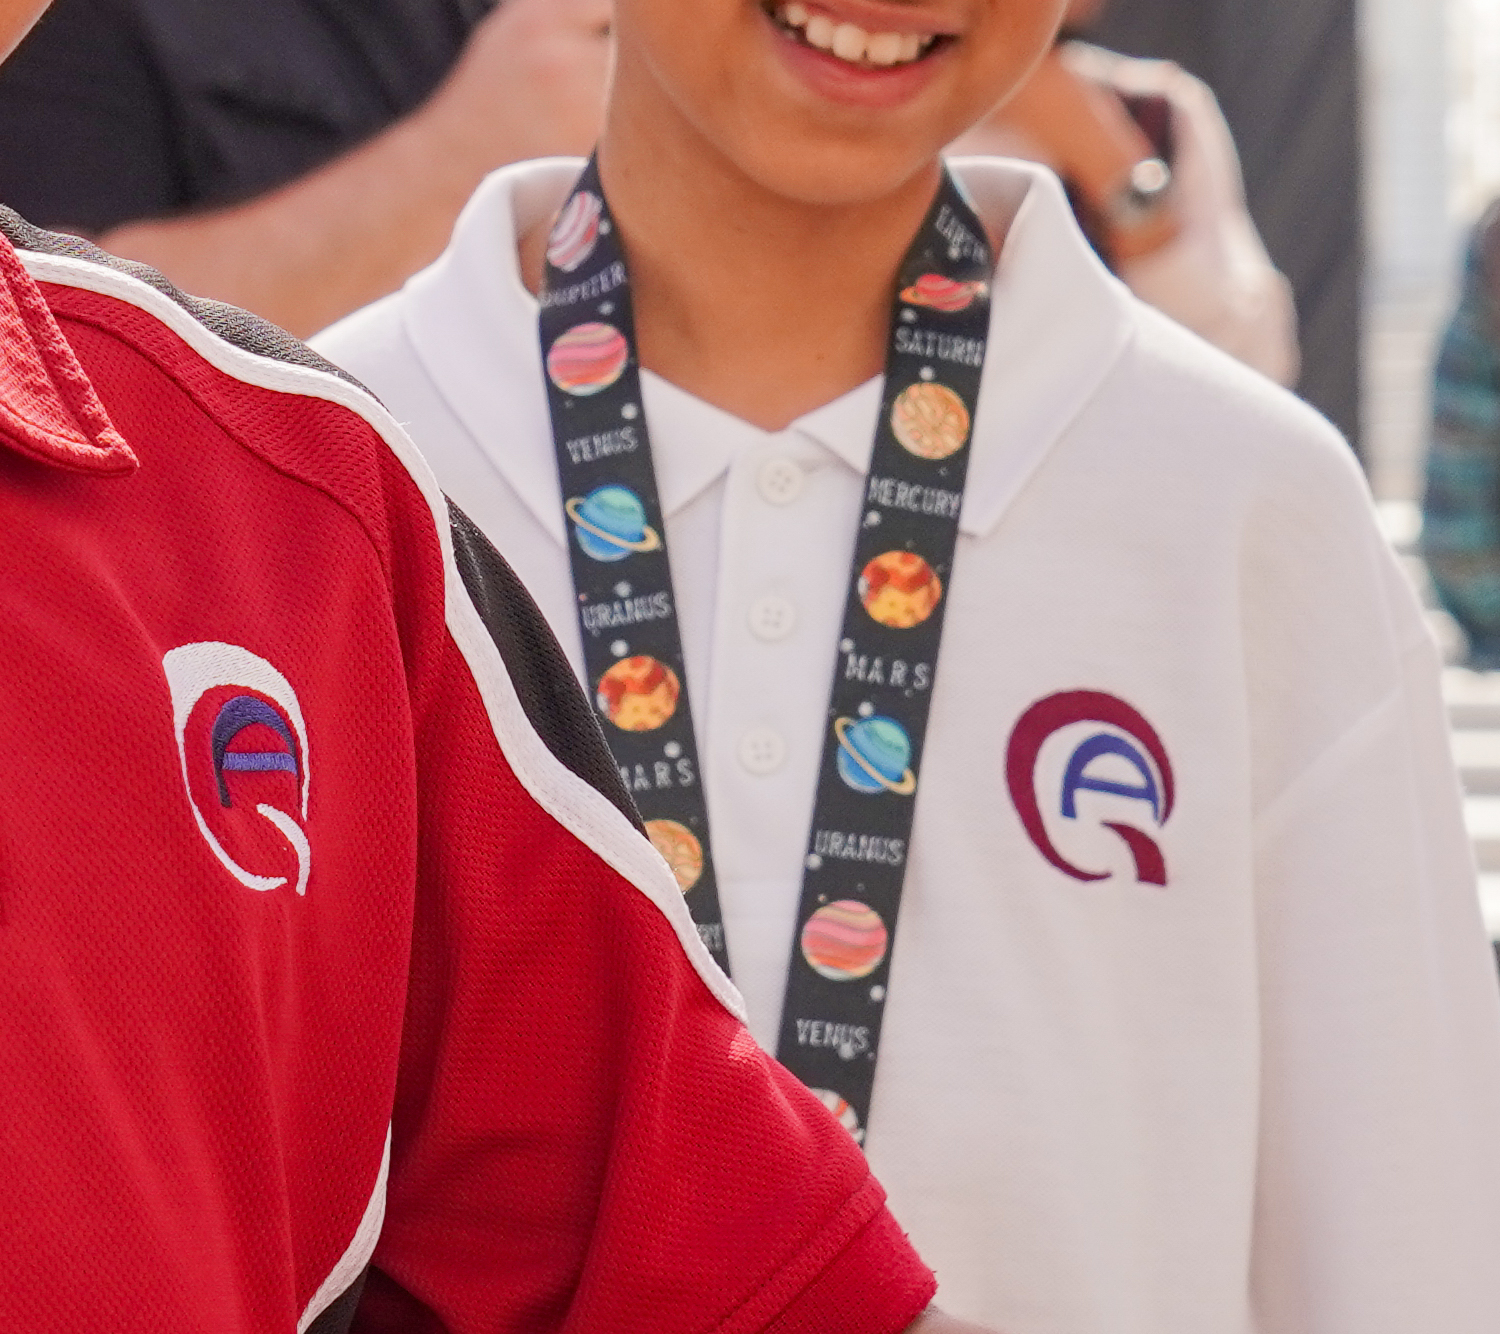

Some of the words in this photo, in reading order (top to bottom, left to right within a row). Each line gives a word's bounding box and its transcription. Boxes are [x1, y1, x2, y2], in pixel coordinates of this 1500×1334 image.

[895, 326, 985, 366] SATURN
[566, 426, 639, 464] VENUS
[868, 476, 961, 517] MERCURY
[582, 591, 673, 630] URANUS
[845, 653, 932, 691] MARS
[814, 829, 905, 866] URANUS
[796, 1018, 870, 1052] VENUS
